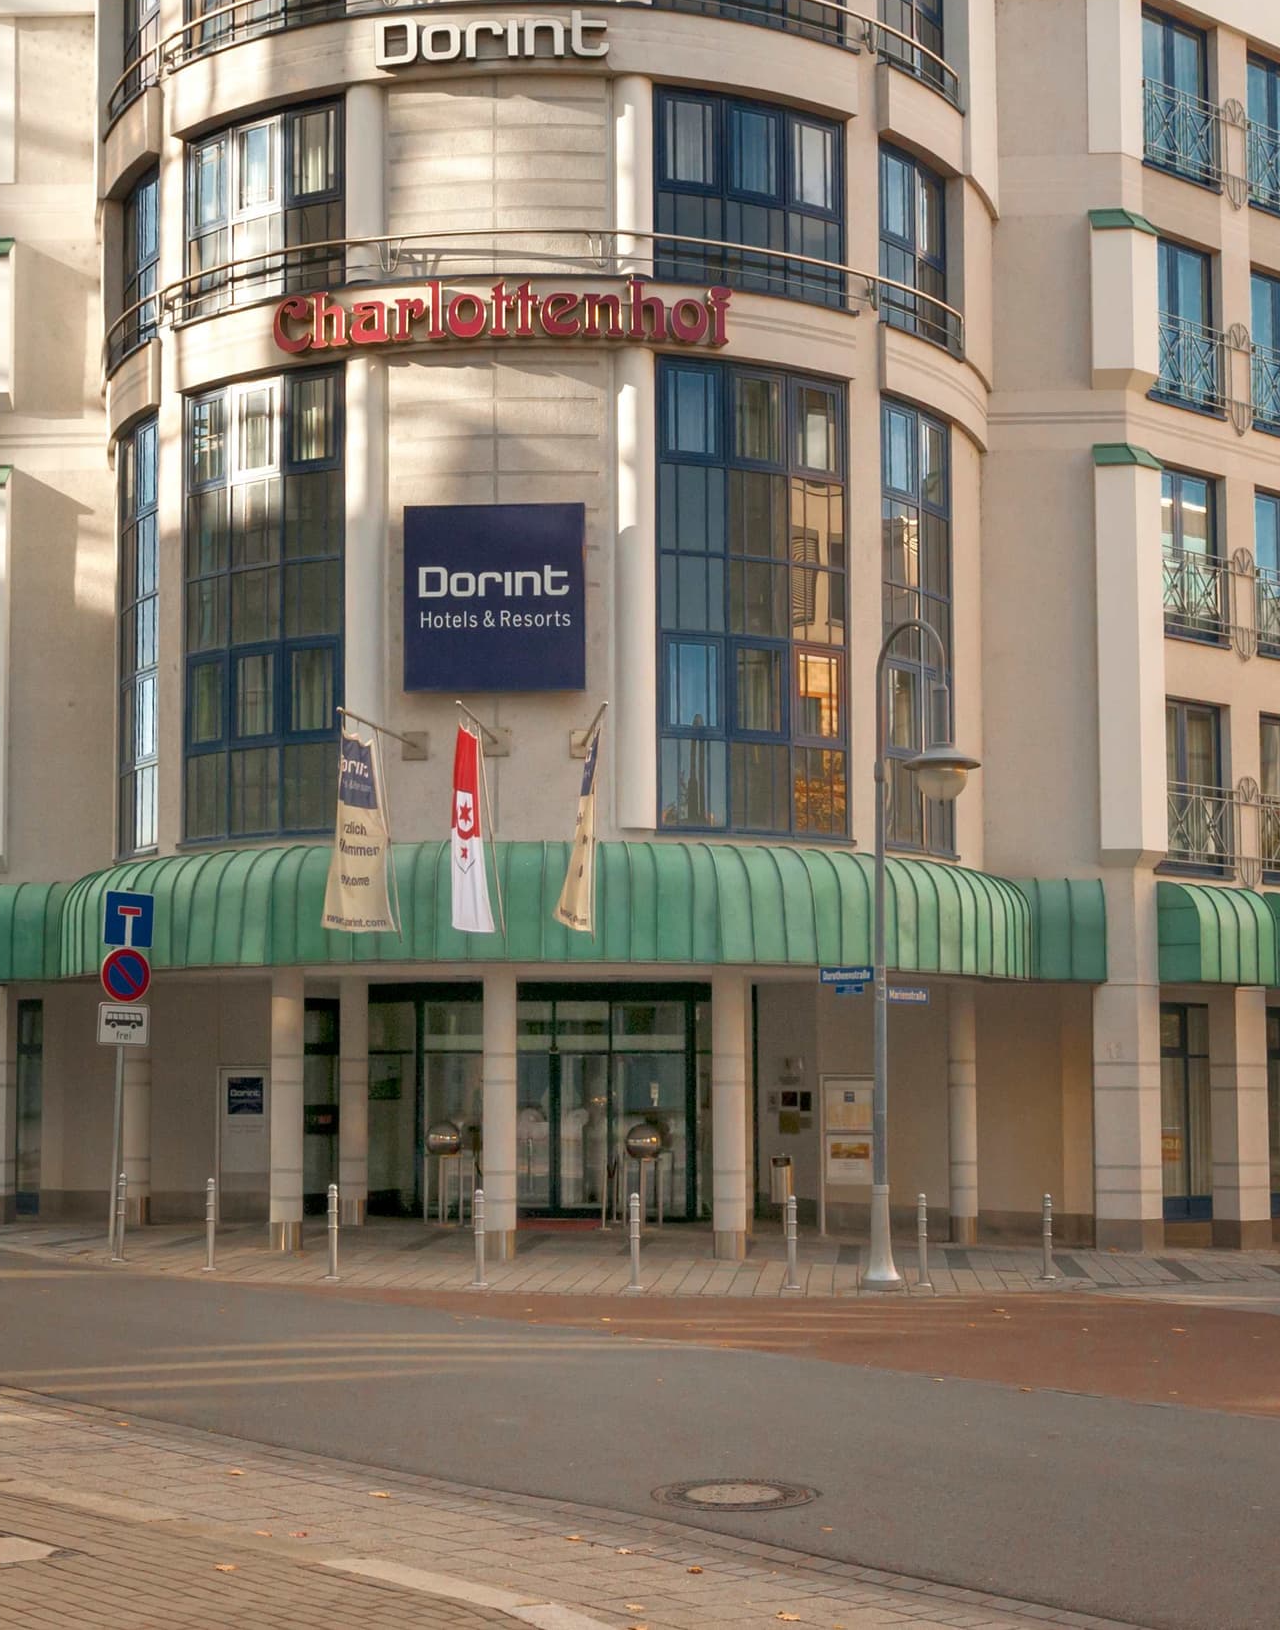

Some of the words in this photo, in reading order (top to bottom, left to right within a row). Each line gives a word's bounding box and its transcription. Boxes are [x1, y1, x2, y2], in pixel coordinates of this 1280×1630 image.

[375, 10, 610, 68] Dorint
[272, 276, 735, 354] Charlottenhof
[418, 564, 570, 598] Dorint
[420, 610, 479, 629] Hotels
[482, 609, 496, 628] &
[500, 609, 572, 628] Resorts
[116, 1031, 132, 1041] frei
